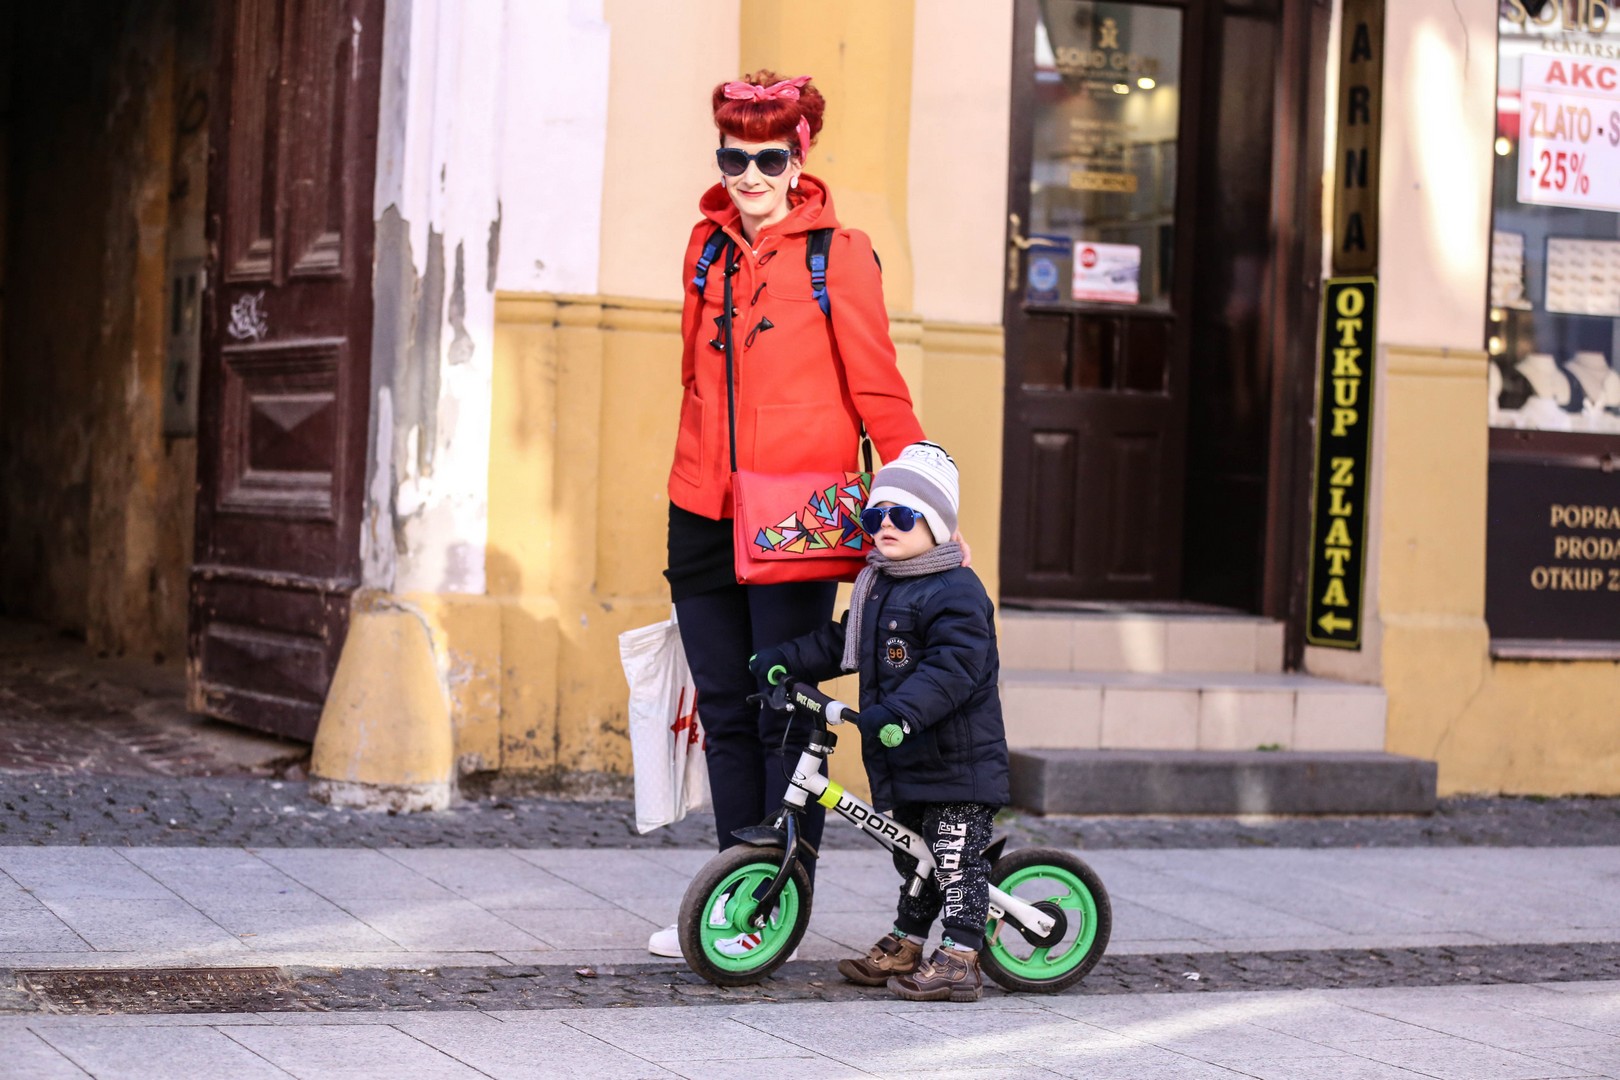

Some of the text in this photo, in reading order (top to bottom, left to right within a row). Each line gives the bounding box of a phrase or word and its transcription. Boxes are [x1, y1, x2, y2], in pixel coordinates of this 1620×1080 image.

[1545, 61, 1617, 91] AKC
[1343, 21, 1372, 253] ARNA
[1529, 101, 1592, 144] ZLATO
[1321, 286, 1365, 607] OTKUP ZLATA
[1551, 504, 1620, 529] POPRA
[1530, 565, 1604, 591] OTKUP
[889, 648, 903, 659] 98
[670, 686, 706, 761] H&
